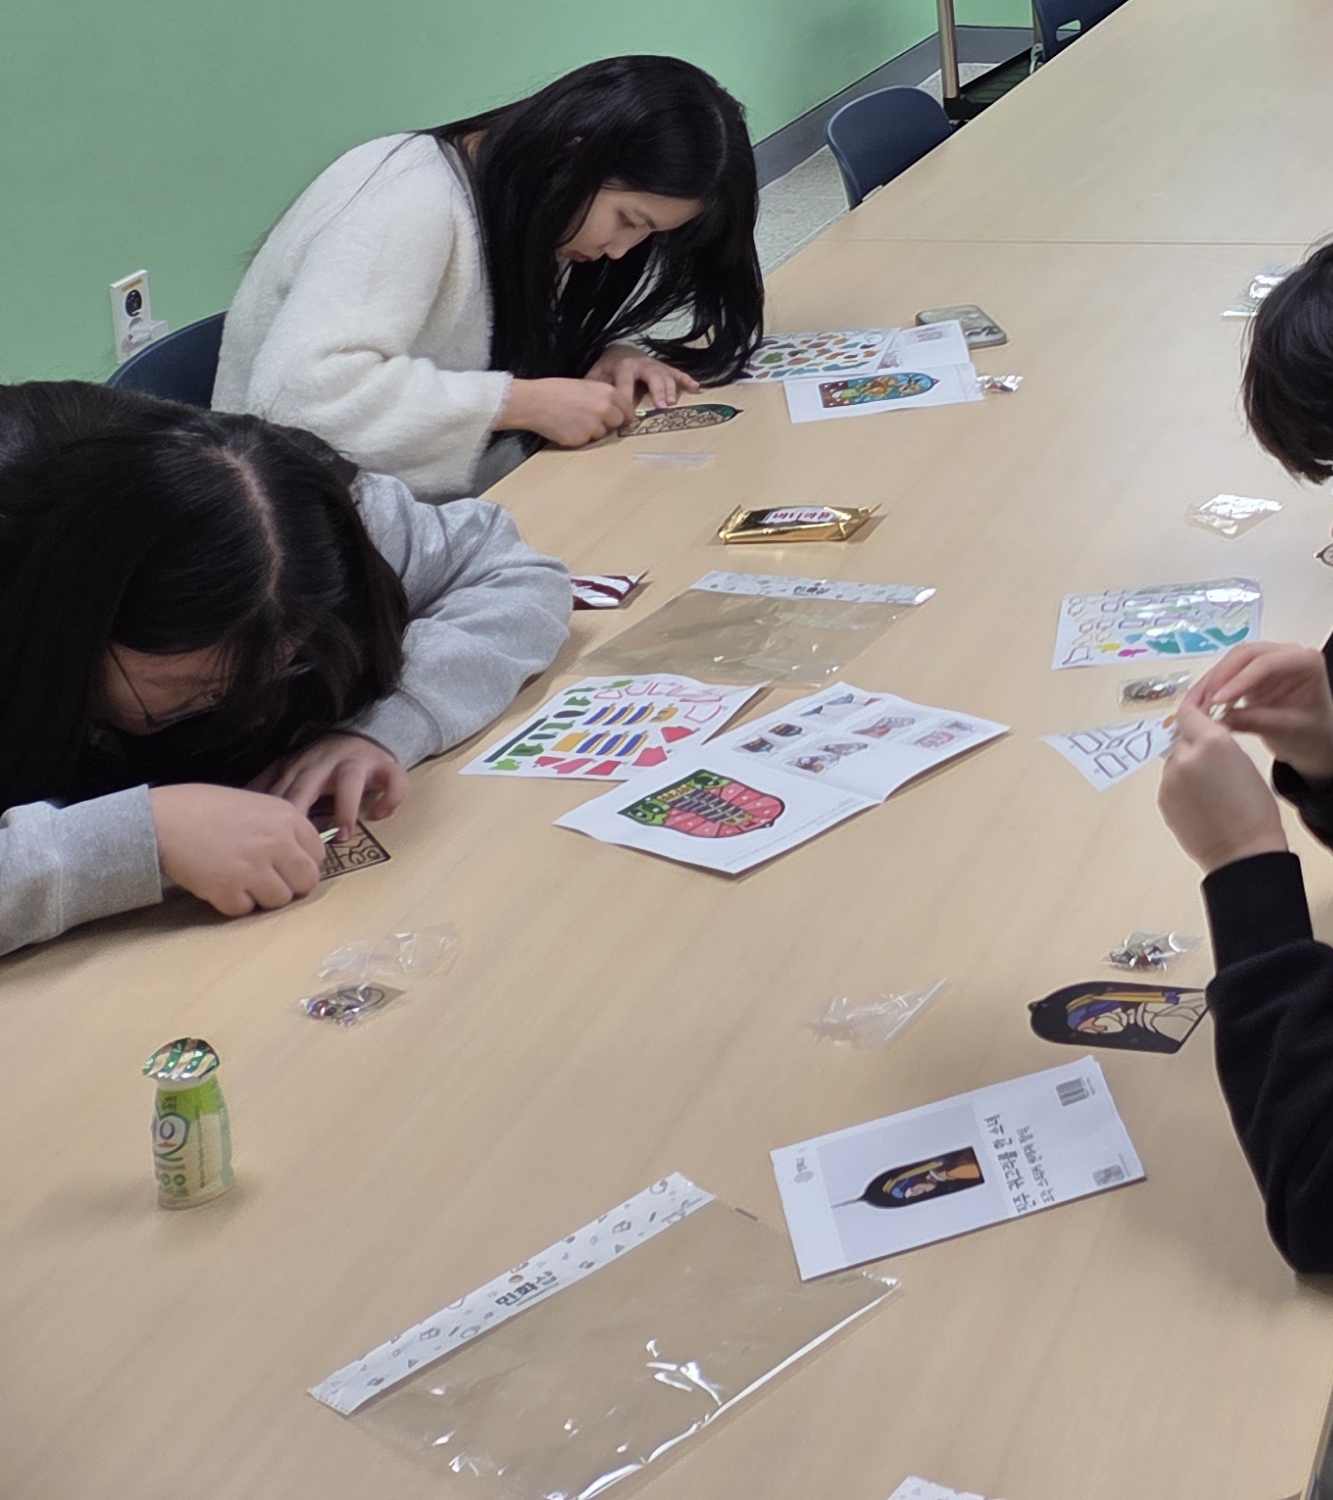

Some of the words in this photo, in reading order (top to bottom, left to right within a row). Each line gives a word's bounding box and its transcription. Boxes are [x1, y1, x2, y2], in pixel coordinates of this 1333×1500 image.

[983, 1113, 1005, 1135] 소녀
[992, 1137, 1013, 1150] 한
[997, 1150, 1025, 1192] 귀고리를
[1012, 1192, 1037, 1213] 진주
[1040, 1187, 1055, 1204] 조각
